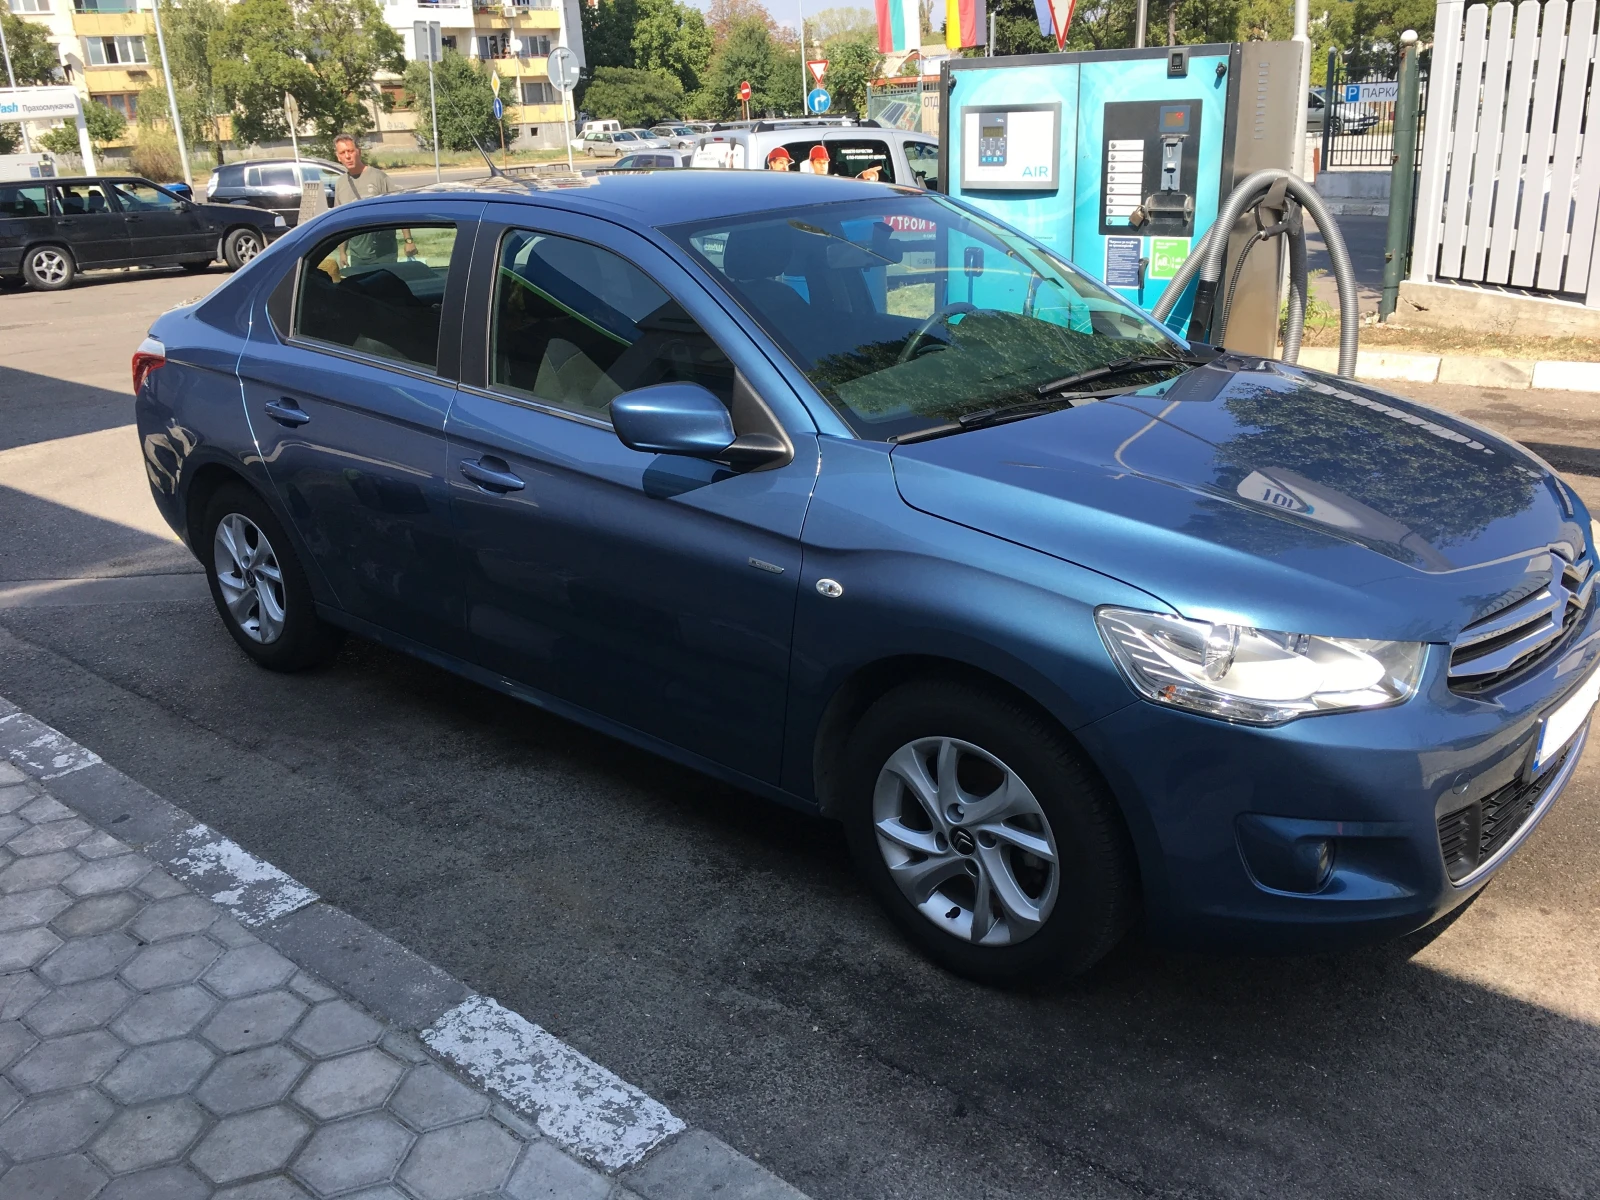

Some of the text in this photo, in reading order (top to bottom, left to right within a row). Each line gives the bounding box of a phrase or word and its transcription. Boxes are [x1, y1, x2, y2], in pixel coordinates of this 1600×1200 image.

[0, 102, 75, 113] ash Прахосмукачка
[1022, 166, 1049, 178] AIR
